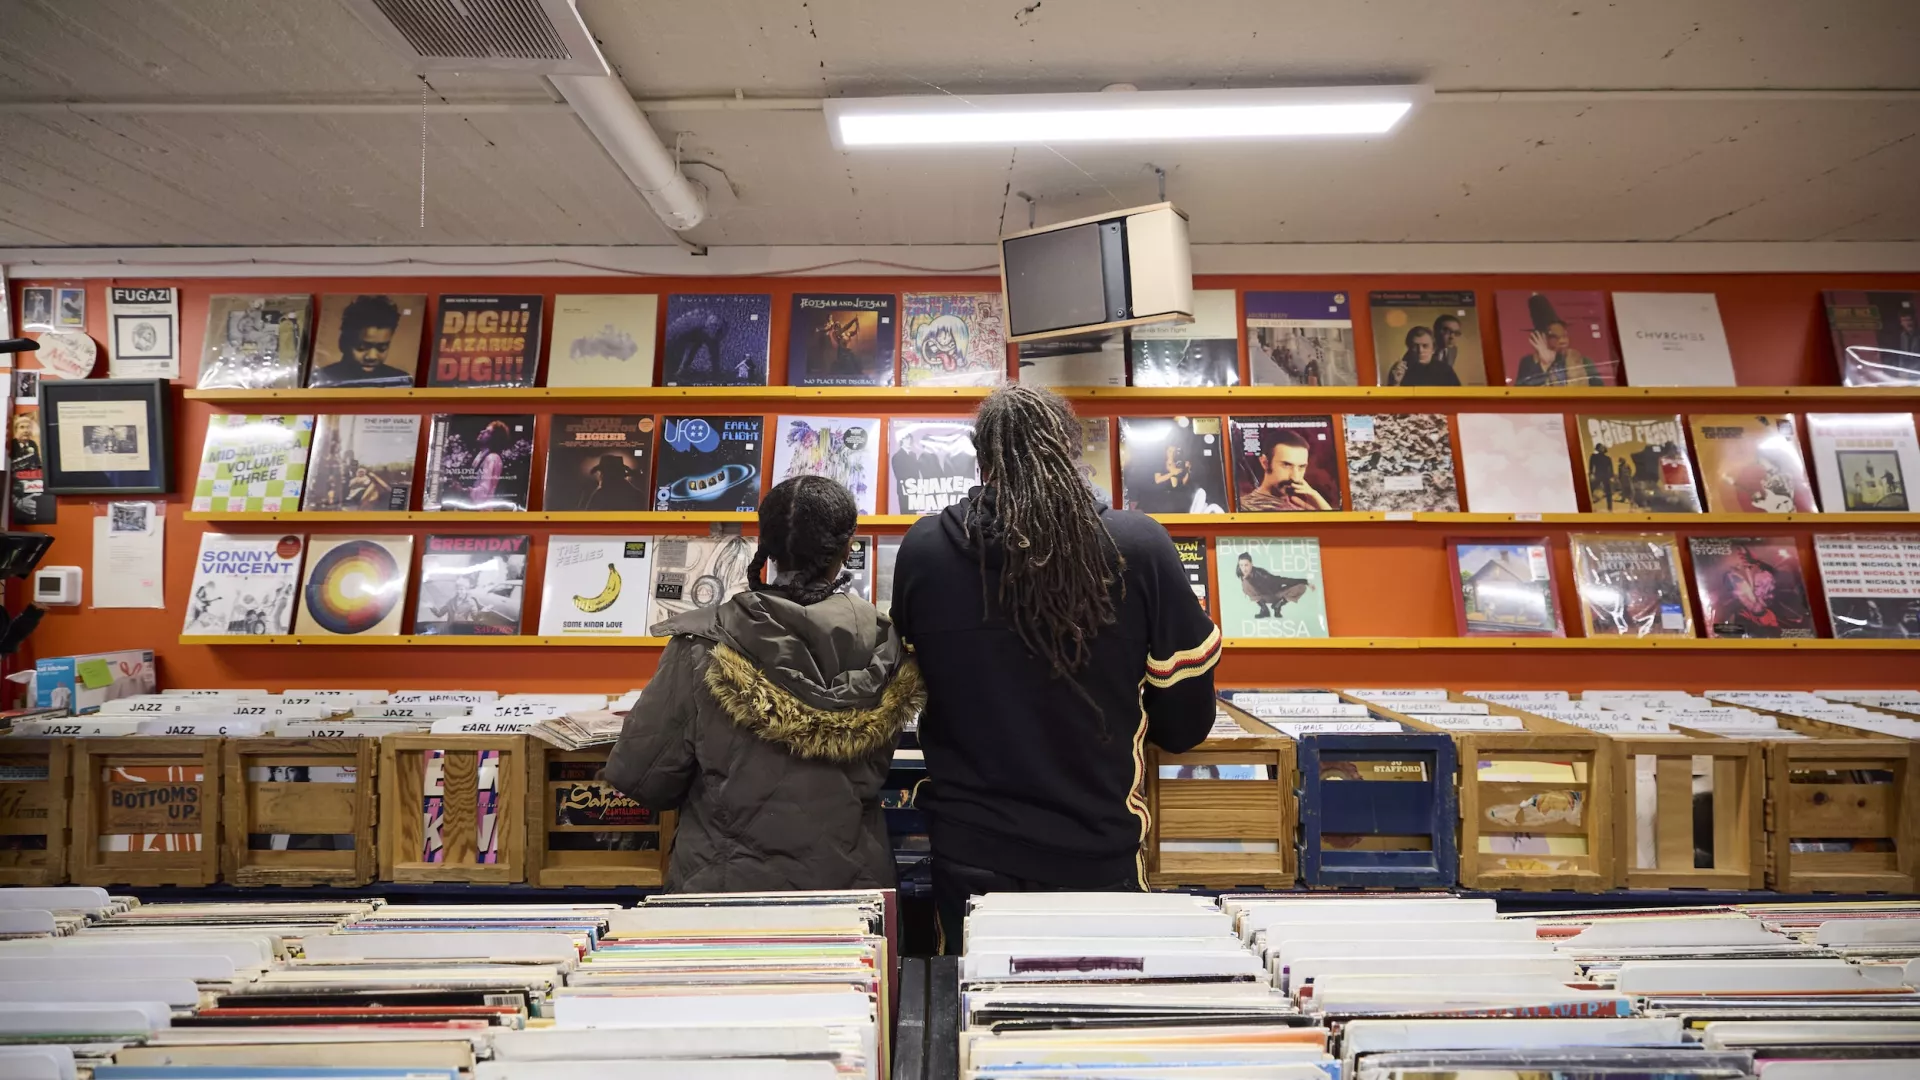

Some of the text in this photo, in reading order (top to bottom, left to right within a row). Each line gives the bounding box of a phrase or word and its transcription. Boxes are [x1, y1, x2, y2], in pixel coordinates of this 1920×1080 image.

[114, 289, 170, 302] FUGAZI
[442, 311, 530, 334] DIG!!!
[440, 337, 525, 353] LAZARUS
[436, 356, 524, 382] DIG!!!
[664, 418, 710, 443] UFO
[724, 421, 759, 430] EARLY
[575, 433, 627, 441] HIGHER
[722, 431, 759, 441] FLIGHT
[209, 438, 302, 463] MID-AMERICA
[227, 455, 285, 473] VOLUME
[233, 469, 278, 486] THREE
[556, 543, 580, 556] THE
[1219, 538, 1319, 555] BURY THE
[202, 551, 277, 562] SONNY
[555, 548, 604, 568] FEELIES
[202, 562, 294, 574] VINCENT
[1270, 555, 1319, 573] LEDE
[1242, 620, 1310, 638] DESSA
[429, 695, 482, 704] HAMILTON
[129, 703, 162, 712] JAZZ
[233, 707, 266, 715] JAZZ
[382, 709, 414, 717] JAZZ
[494, 706, 533, 717] JAZZ
[42, 725, 82, 735] JAZZ
[165, 726, 227, 735] JAZZ C
[461, 723, 492, 732] EARL
[1374, 765, 1421, 773] STAFFORD
[111, 786, 198, 809] BOTTOMS
